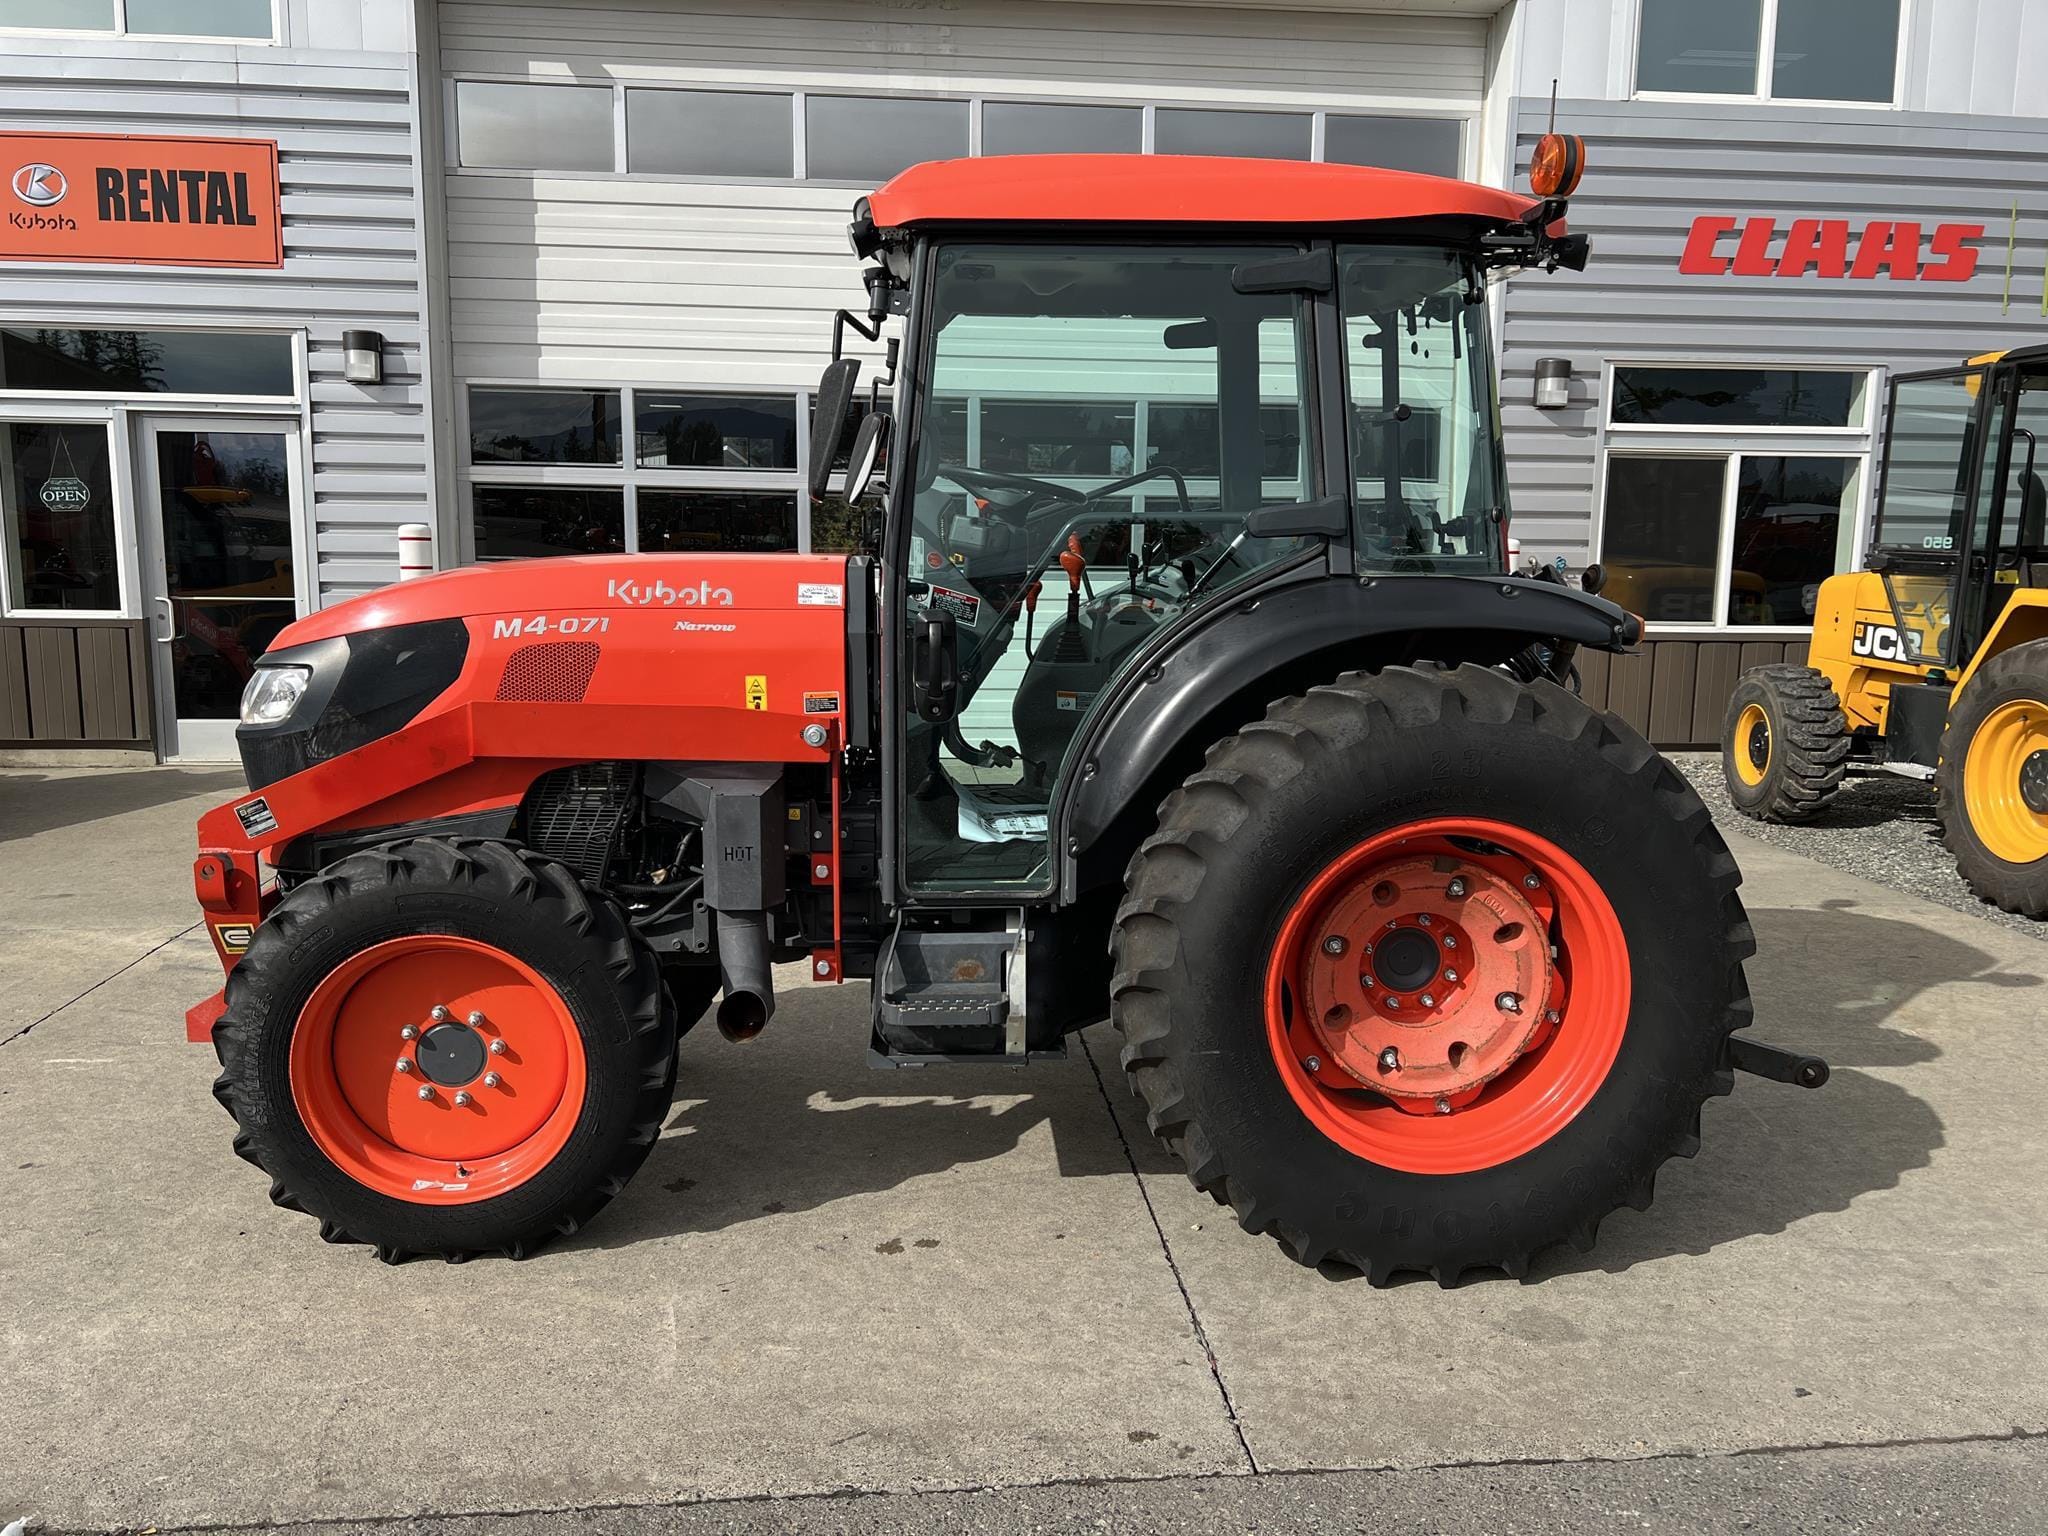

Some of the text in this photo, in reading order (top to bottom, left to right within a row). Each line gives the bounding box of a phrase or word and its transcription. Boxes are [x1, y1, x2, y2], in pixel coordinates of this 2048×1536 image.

[96, 167, 257, 226] RENTAL
[9, 212, 77, 231] Kubota
[1678, 216, 1985, 282] CLAAS
[42, 490, 87, 502] OPEN
[607, 579, 734, 606] Kubota
[492, 615, 610, 640] M4-071
[672, 620, 737, 632] Narrow
[1853, 625, 1922, 662] JCB
[724, 846, 754, 861] HOT
